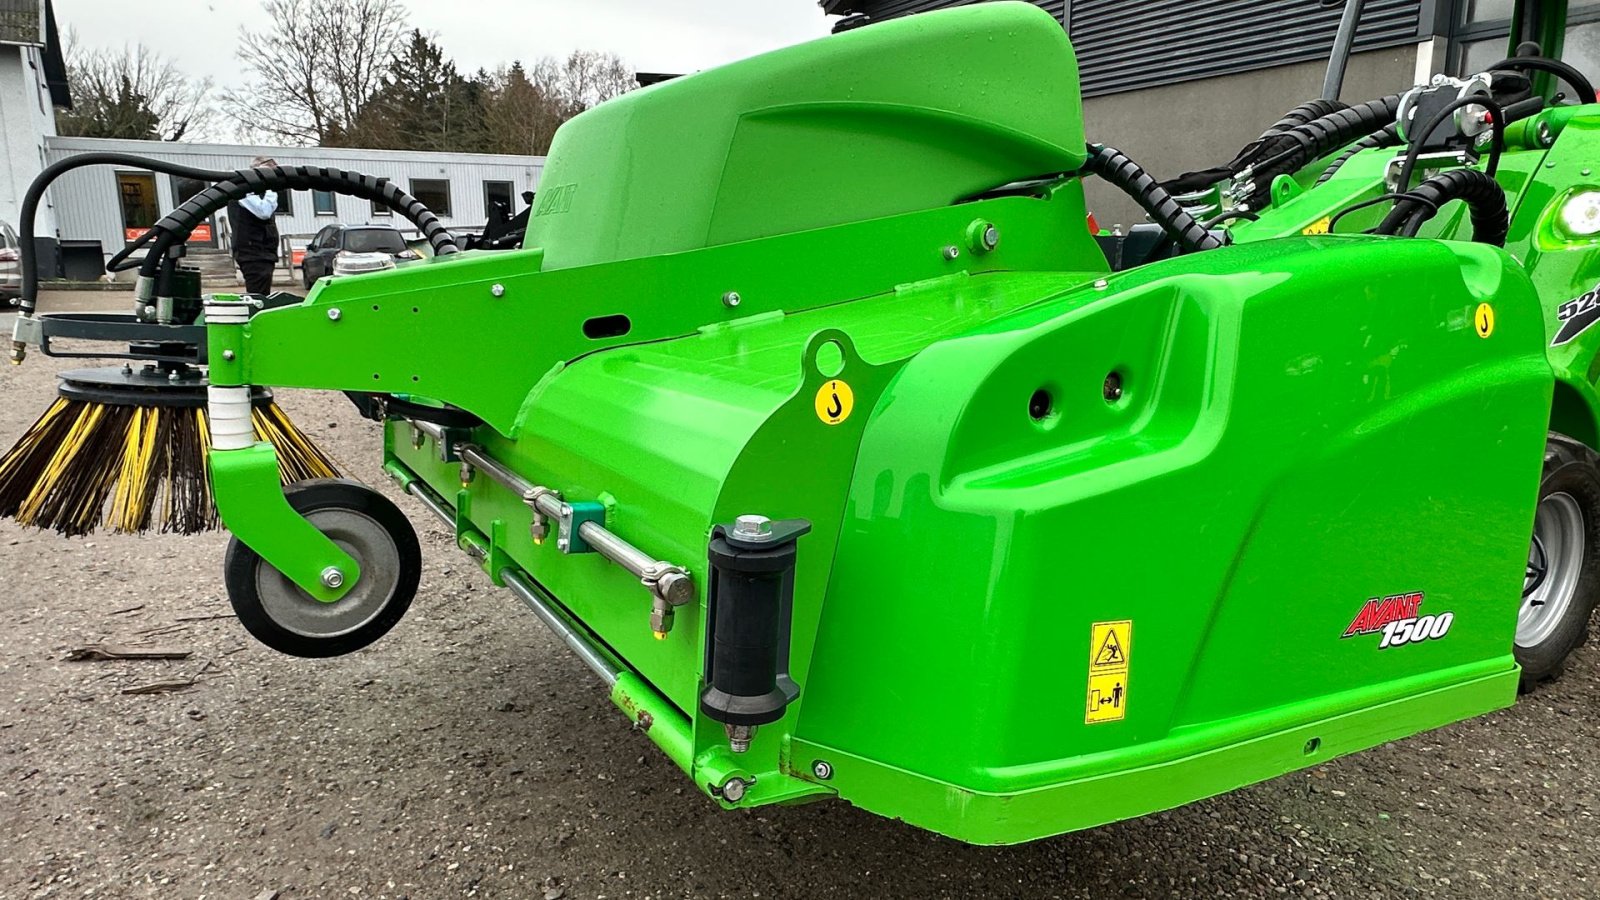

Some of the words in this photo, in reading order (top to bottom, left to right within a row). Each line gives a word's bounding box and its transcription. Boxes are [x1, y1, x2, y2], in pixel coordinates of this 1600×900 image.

[1557, 284, 1600, 321] 52
[1342, 592, 1424, 638] AVANT
[1379, 612, 1454, 648] 1500
